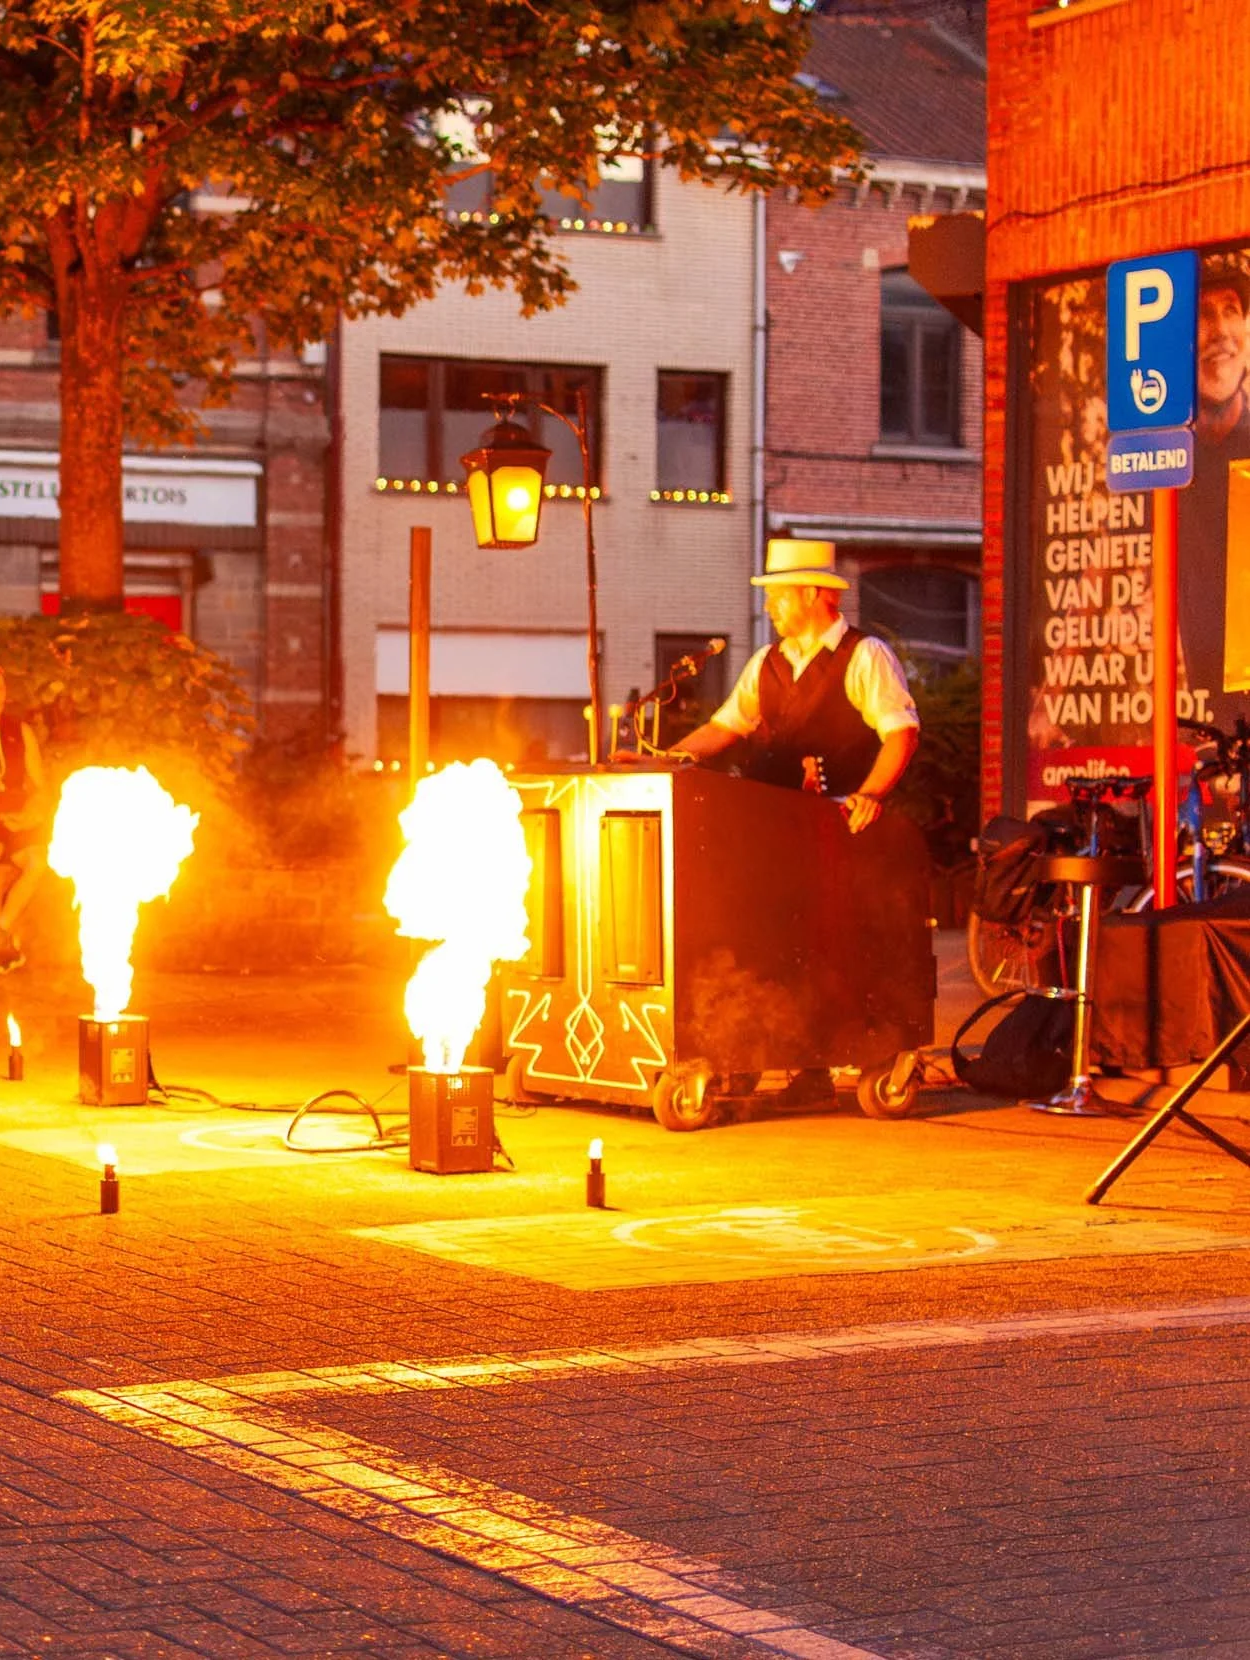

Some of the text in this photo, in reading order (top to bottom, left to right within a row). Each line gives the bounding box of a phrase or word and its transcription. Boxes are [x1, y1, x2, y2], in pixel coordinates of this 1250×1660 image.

[1125, 268, 1174, 362] P
[1046, 462, 1095, 497] WIJ
[1110, 448, 1188, 475] BETALEND
[124, 485, 188, 505] RTOIS
[1046, 493, 1145, 535] HELPEN
[1045, 532, 1153, 574] GENIETE
[1045, 569, 1146, 611] VAN DE
[1045, 611, 1154, 651] GELUIDE
[1044, 651, 1155, 687] WAAR U
[1044, 688, 1215, 726] VAN HODT.
